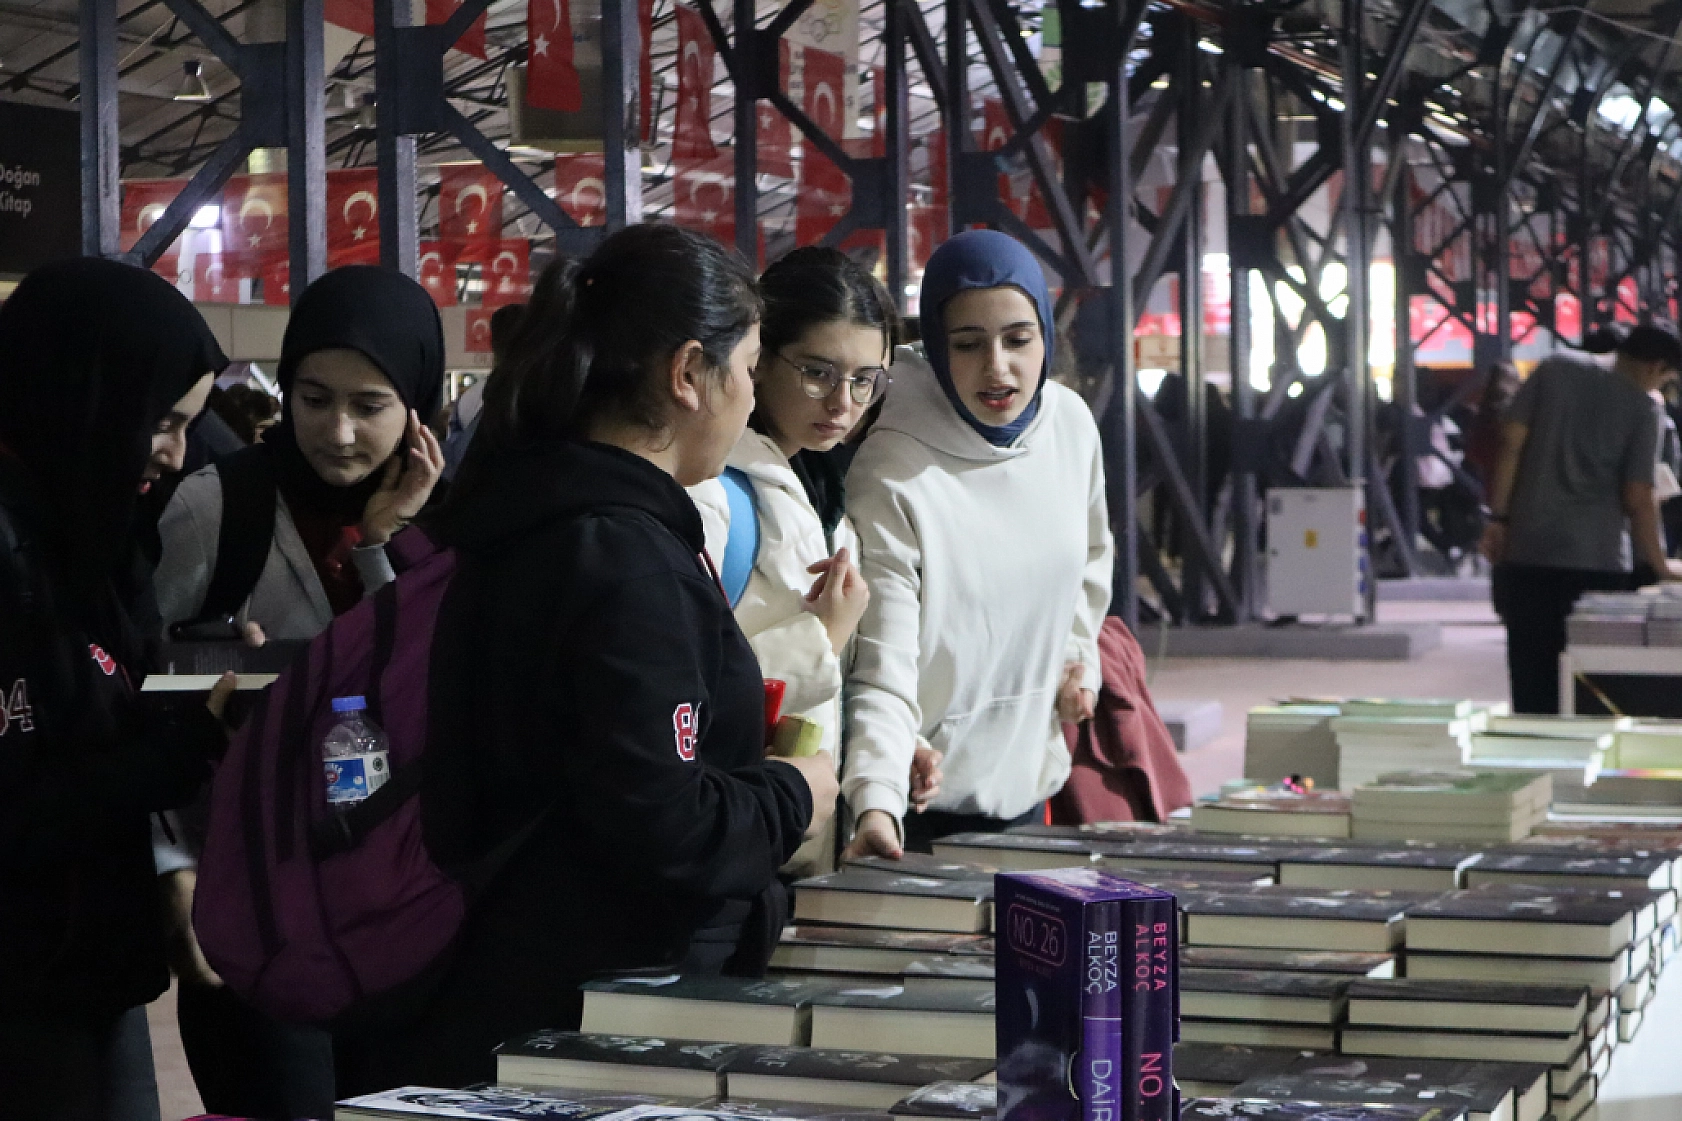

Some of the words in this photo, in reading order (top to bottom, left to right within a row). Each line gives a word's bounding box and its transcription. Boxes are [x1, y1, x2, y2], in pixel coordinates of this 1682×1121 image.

[1014, 913, 1036, 949] NO.
[1041, 922, 1059, 956] 26
[1085, 931, 1103, 994] ALKOÇ
[1105, 931, 1117, 993] BEYZA
[1133, 924, 1150, 991] ALKOÇ
[1153, 922, 1167, 991] BEYZA
